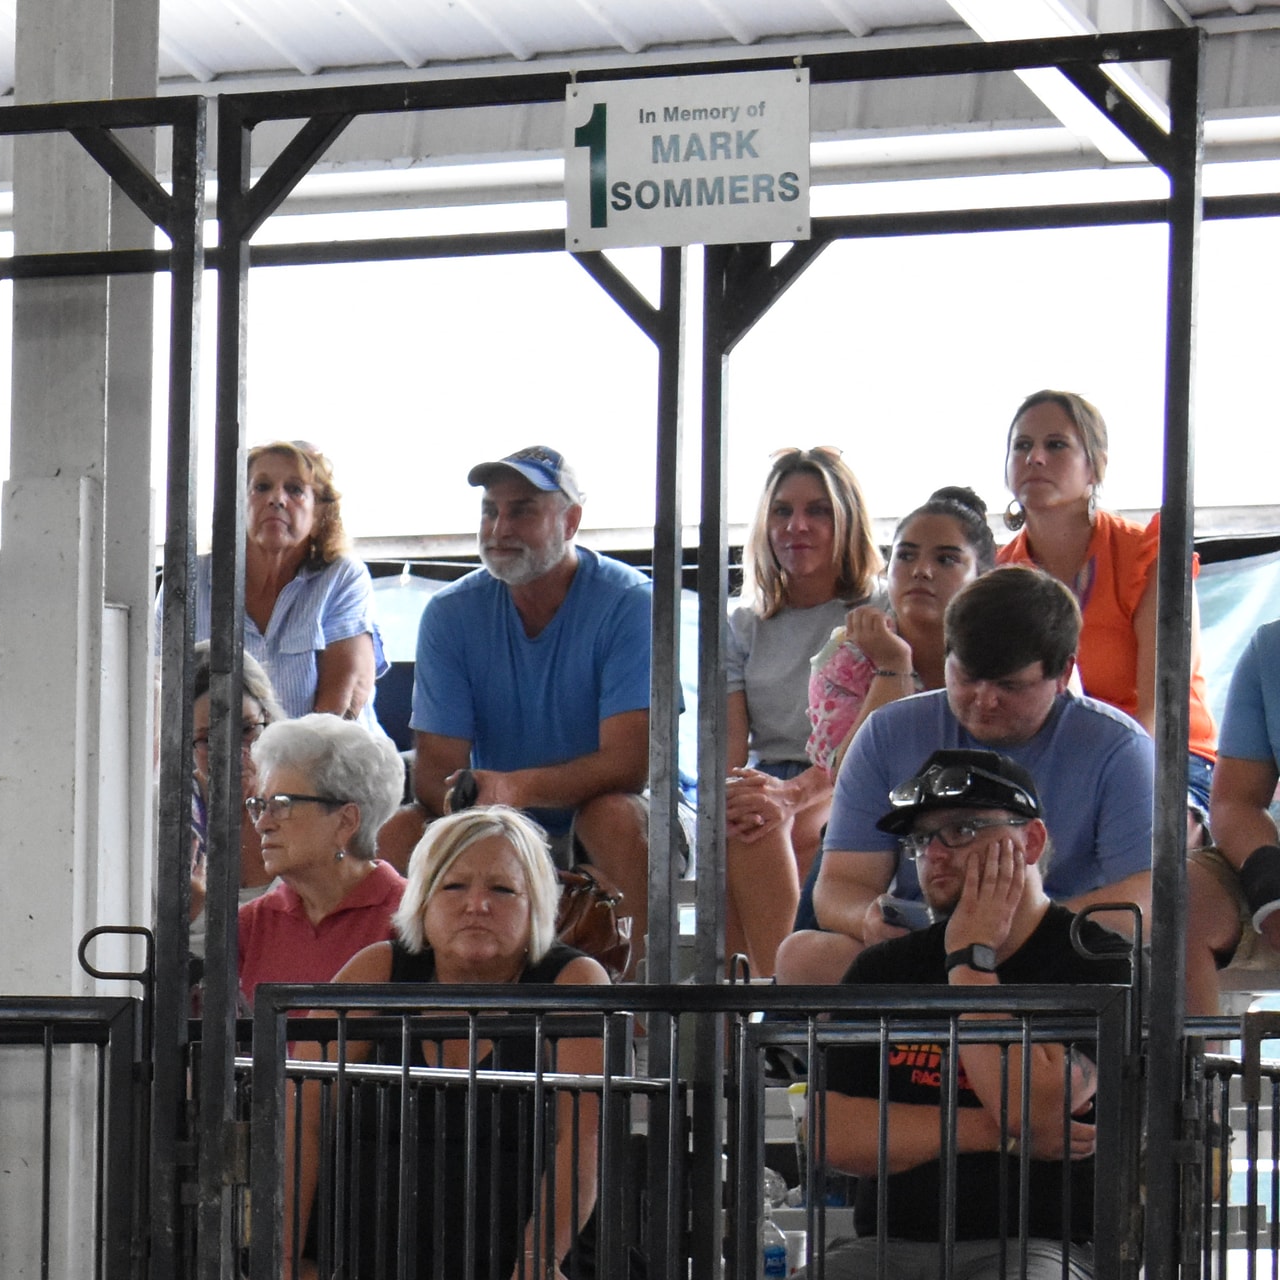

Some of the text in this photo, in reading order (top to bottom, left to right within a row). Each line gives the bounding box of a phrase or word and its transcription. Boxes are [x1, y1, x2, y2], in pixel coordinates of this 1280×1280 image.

[639, 101, 766, 124] In Memory of
[652, 129, 760, 164] MARK
[574, 103, 607, 228] 1
[611, 171, 801, 211] SOMMERS
